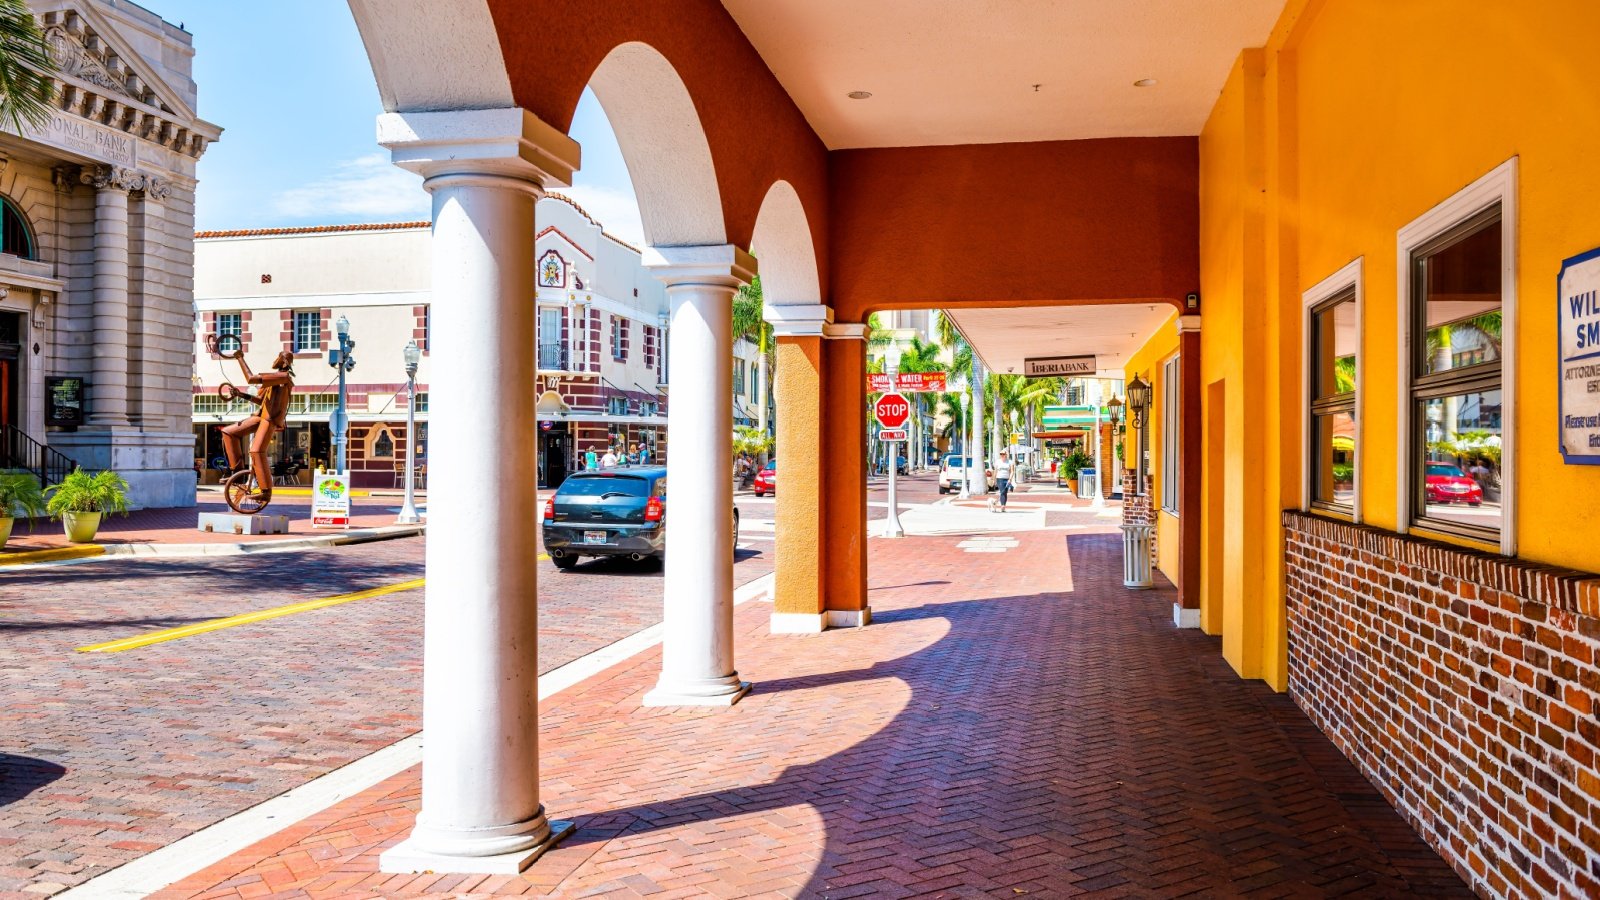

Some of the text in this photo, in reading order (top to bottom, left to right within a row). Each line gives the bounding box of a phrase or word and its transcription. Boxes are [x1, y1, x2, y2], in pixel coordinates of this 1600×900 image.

[95, 129, 127, 152] BANK
[1576, 321, 1600, 349] SM
[871, 374, 890, 384] SMOK
[900, 374, 923, 383] WATER
[878, 404, 907, 417] STOP
[1565, 414, 1585, 428] Please
[1585, 416, 1598, 428] use
